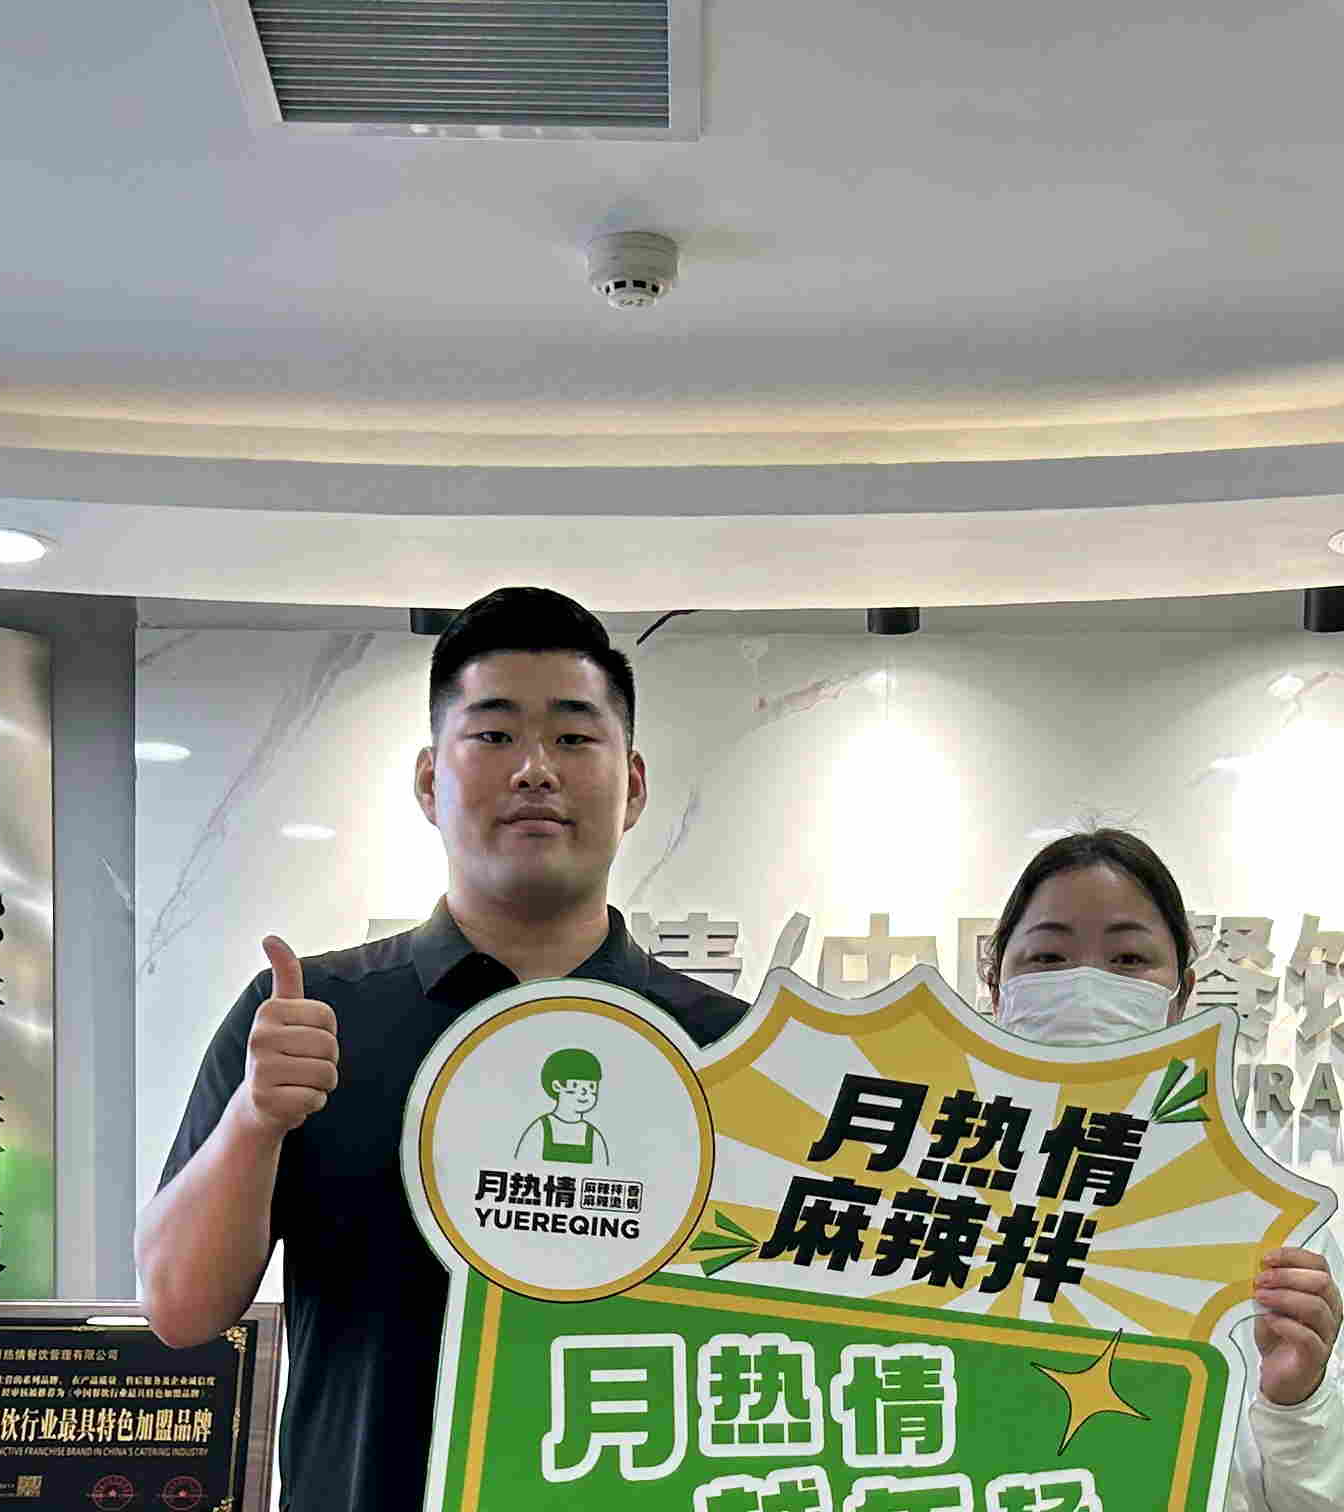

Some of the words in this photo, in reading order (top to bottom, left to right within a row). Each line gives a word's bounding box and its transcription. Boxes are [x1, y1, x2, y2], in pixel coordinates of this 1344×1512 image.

[475, 1170, 576, 1208] 月热情
[809, 1073, 1150, 1209] 月热情
[475, 1207, 640, 1239] YUEREQING
[759, 1177, 1098, 1304] 麻辣拌
[541, 1333, 957, 1483] 月热情
